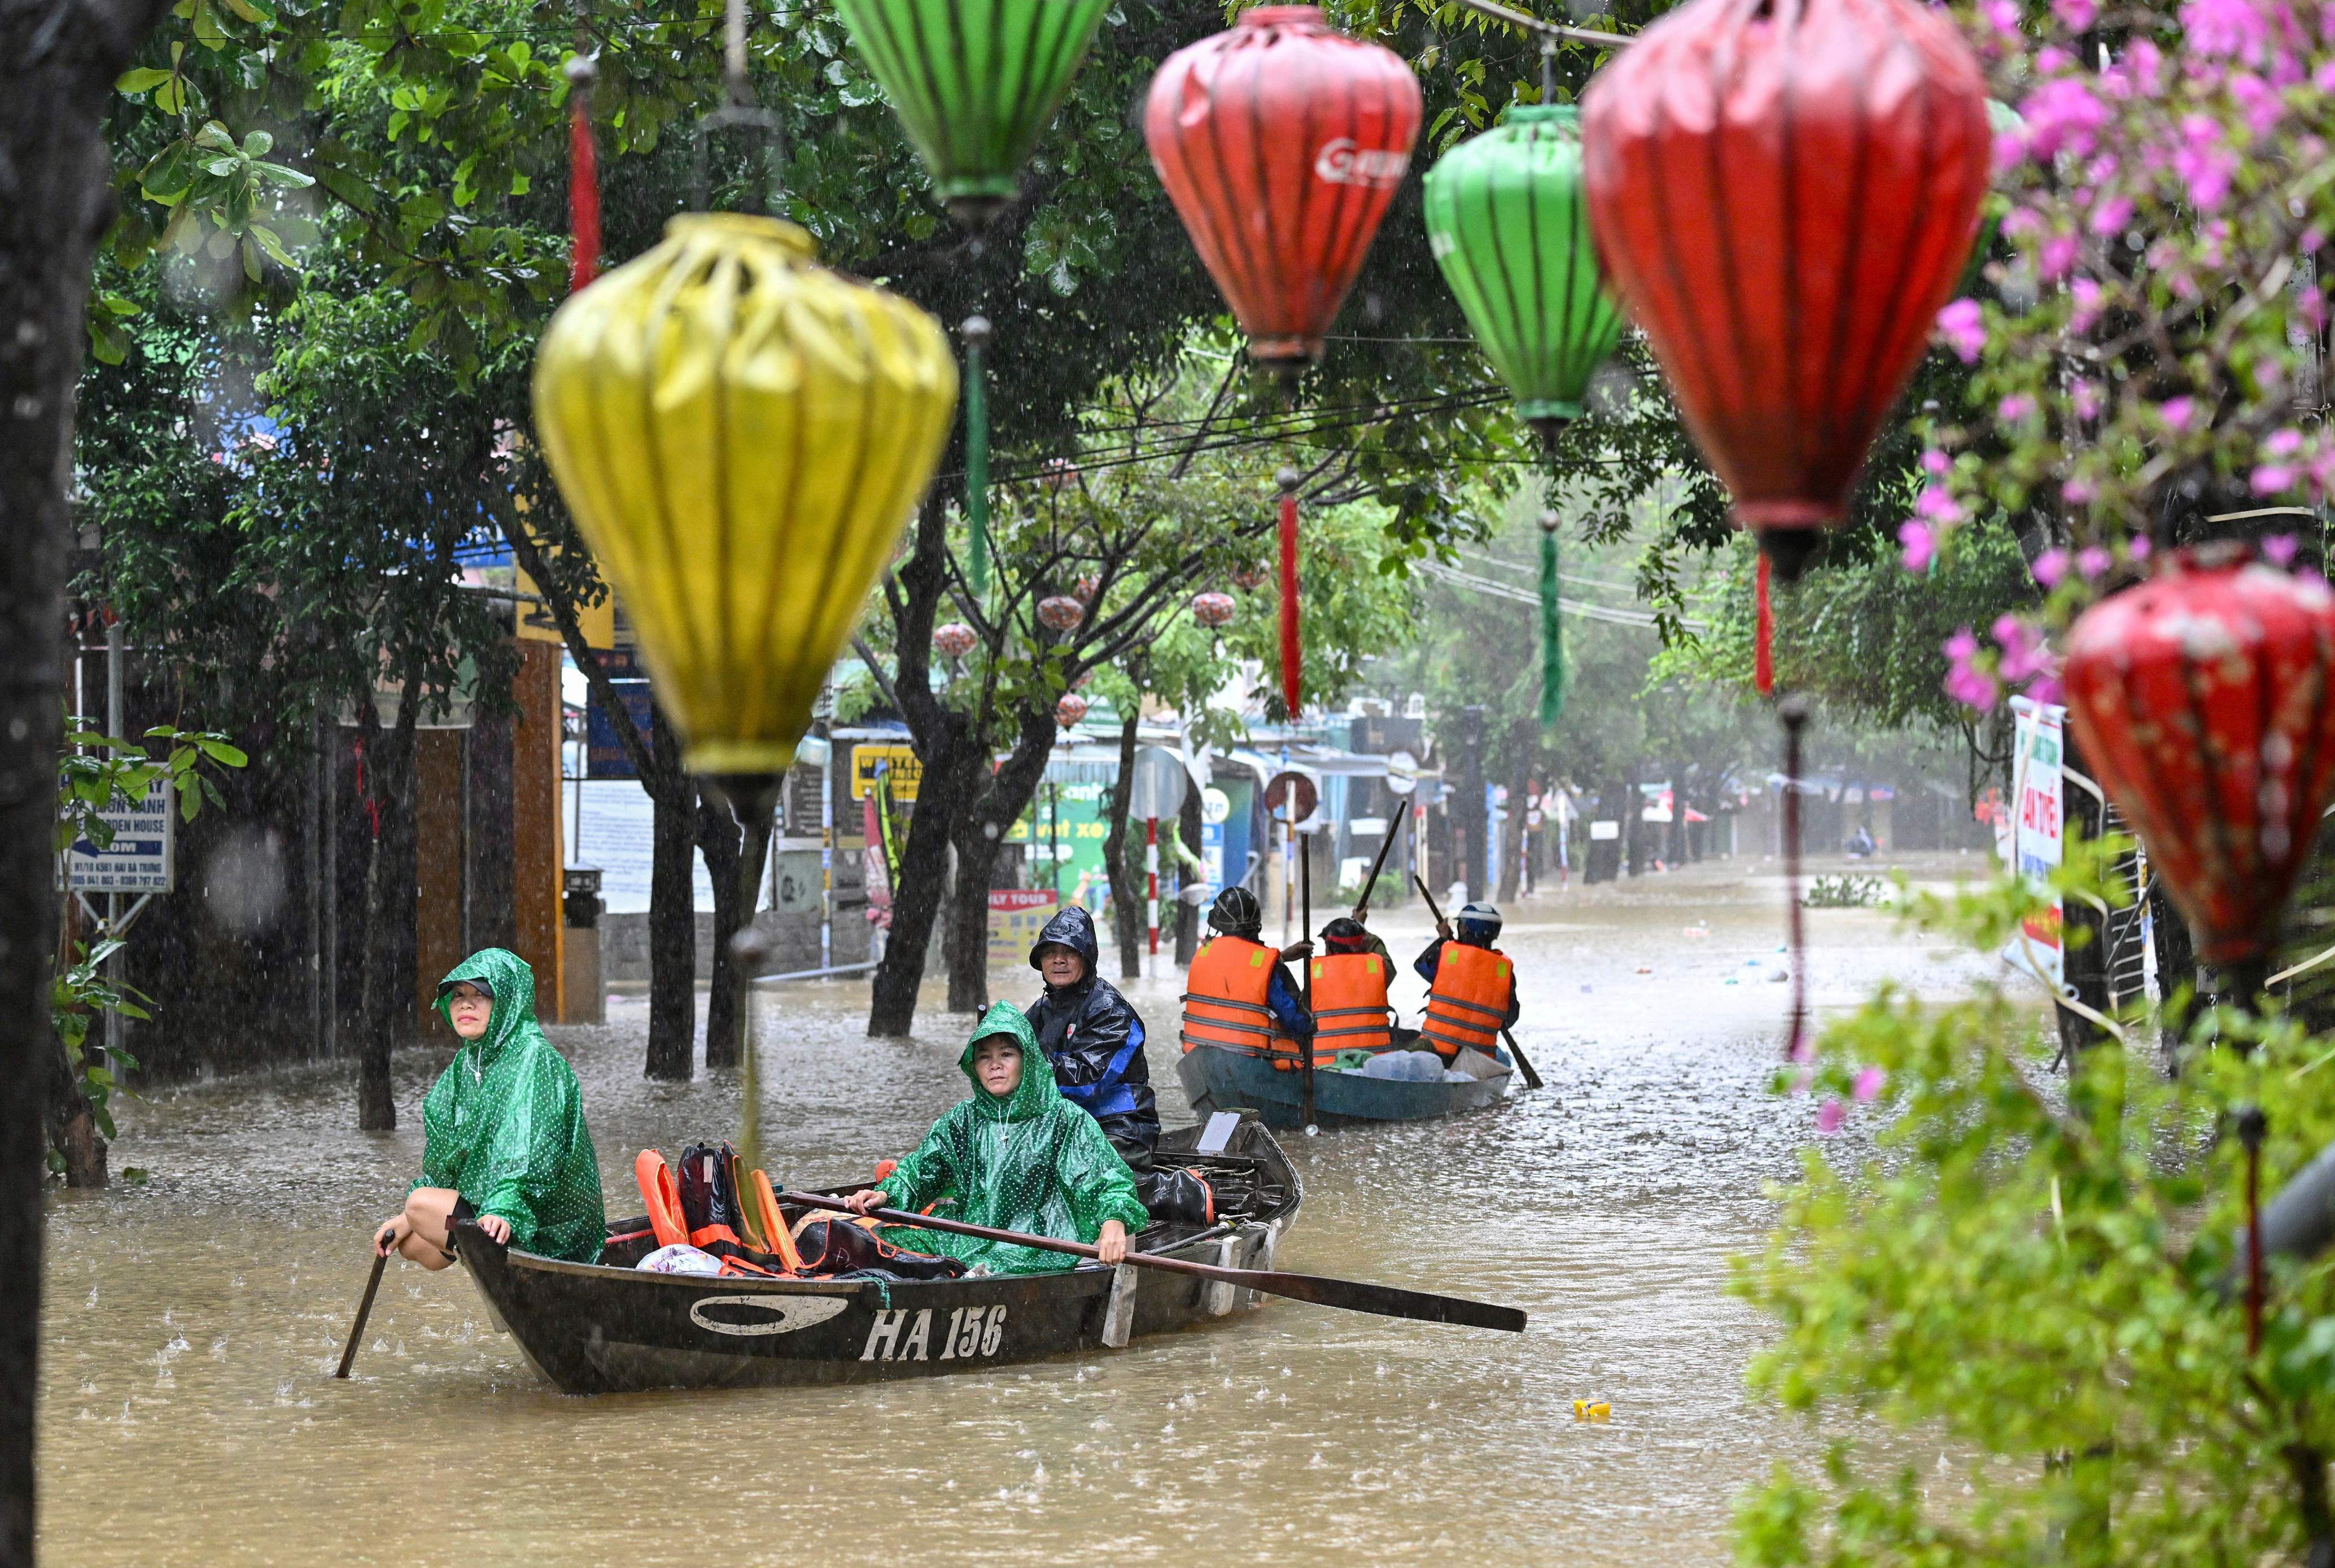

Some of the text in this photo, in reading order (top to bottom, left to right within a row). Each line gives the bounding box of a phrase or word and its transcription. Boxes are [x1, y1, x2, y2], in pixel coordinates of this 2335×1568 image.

[134, 819, 165, 833] HOUSE
[1010, 893, 1048, 905] TOUR
[859, 1304, 1007, 1361] HA 156
